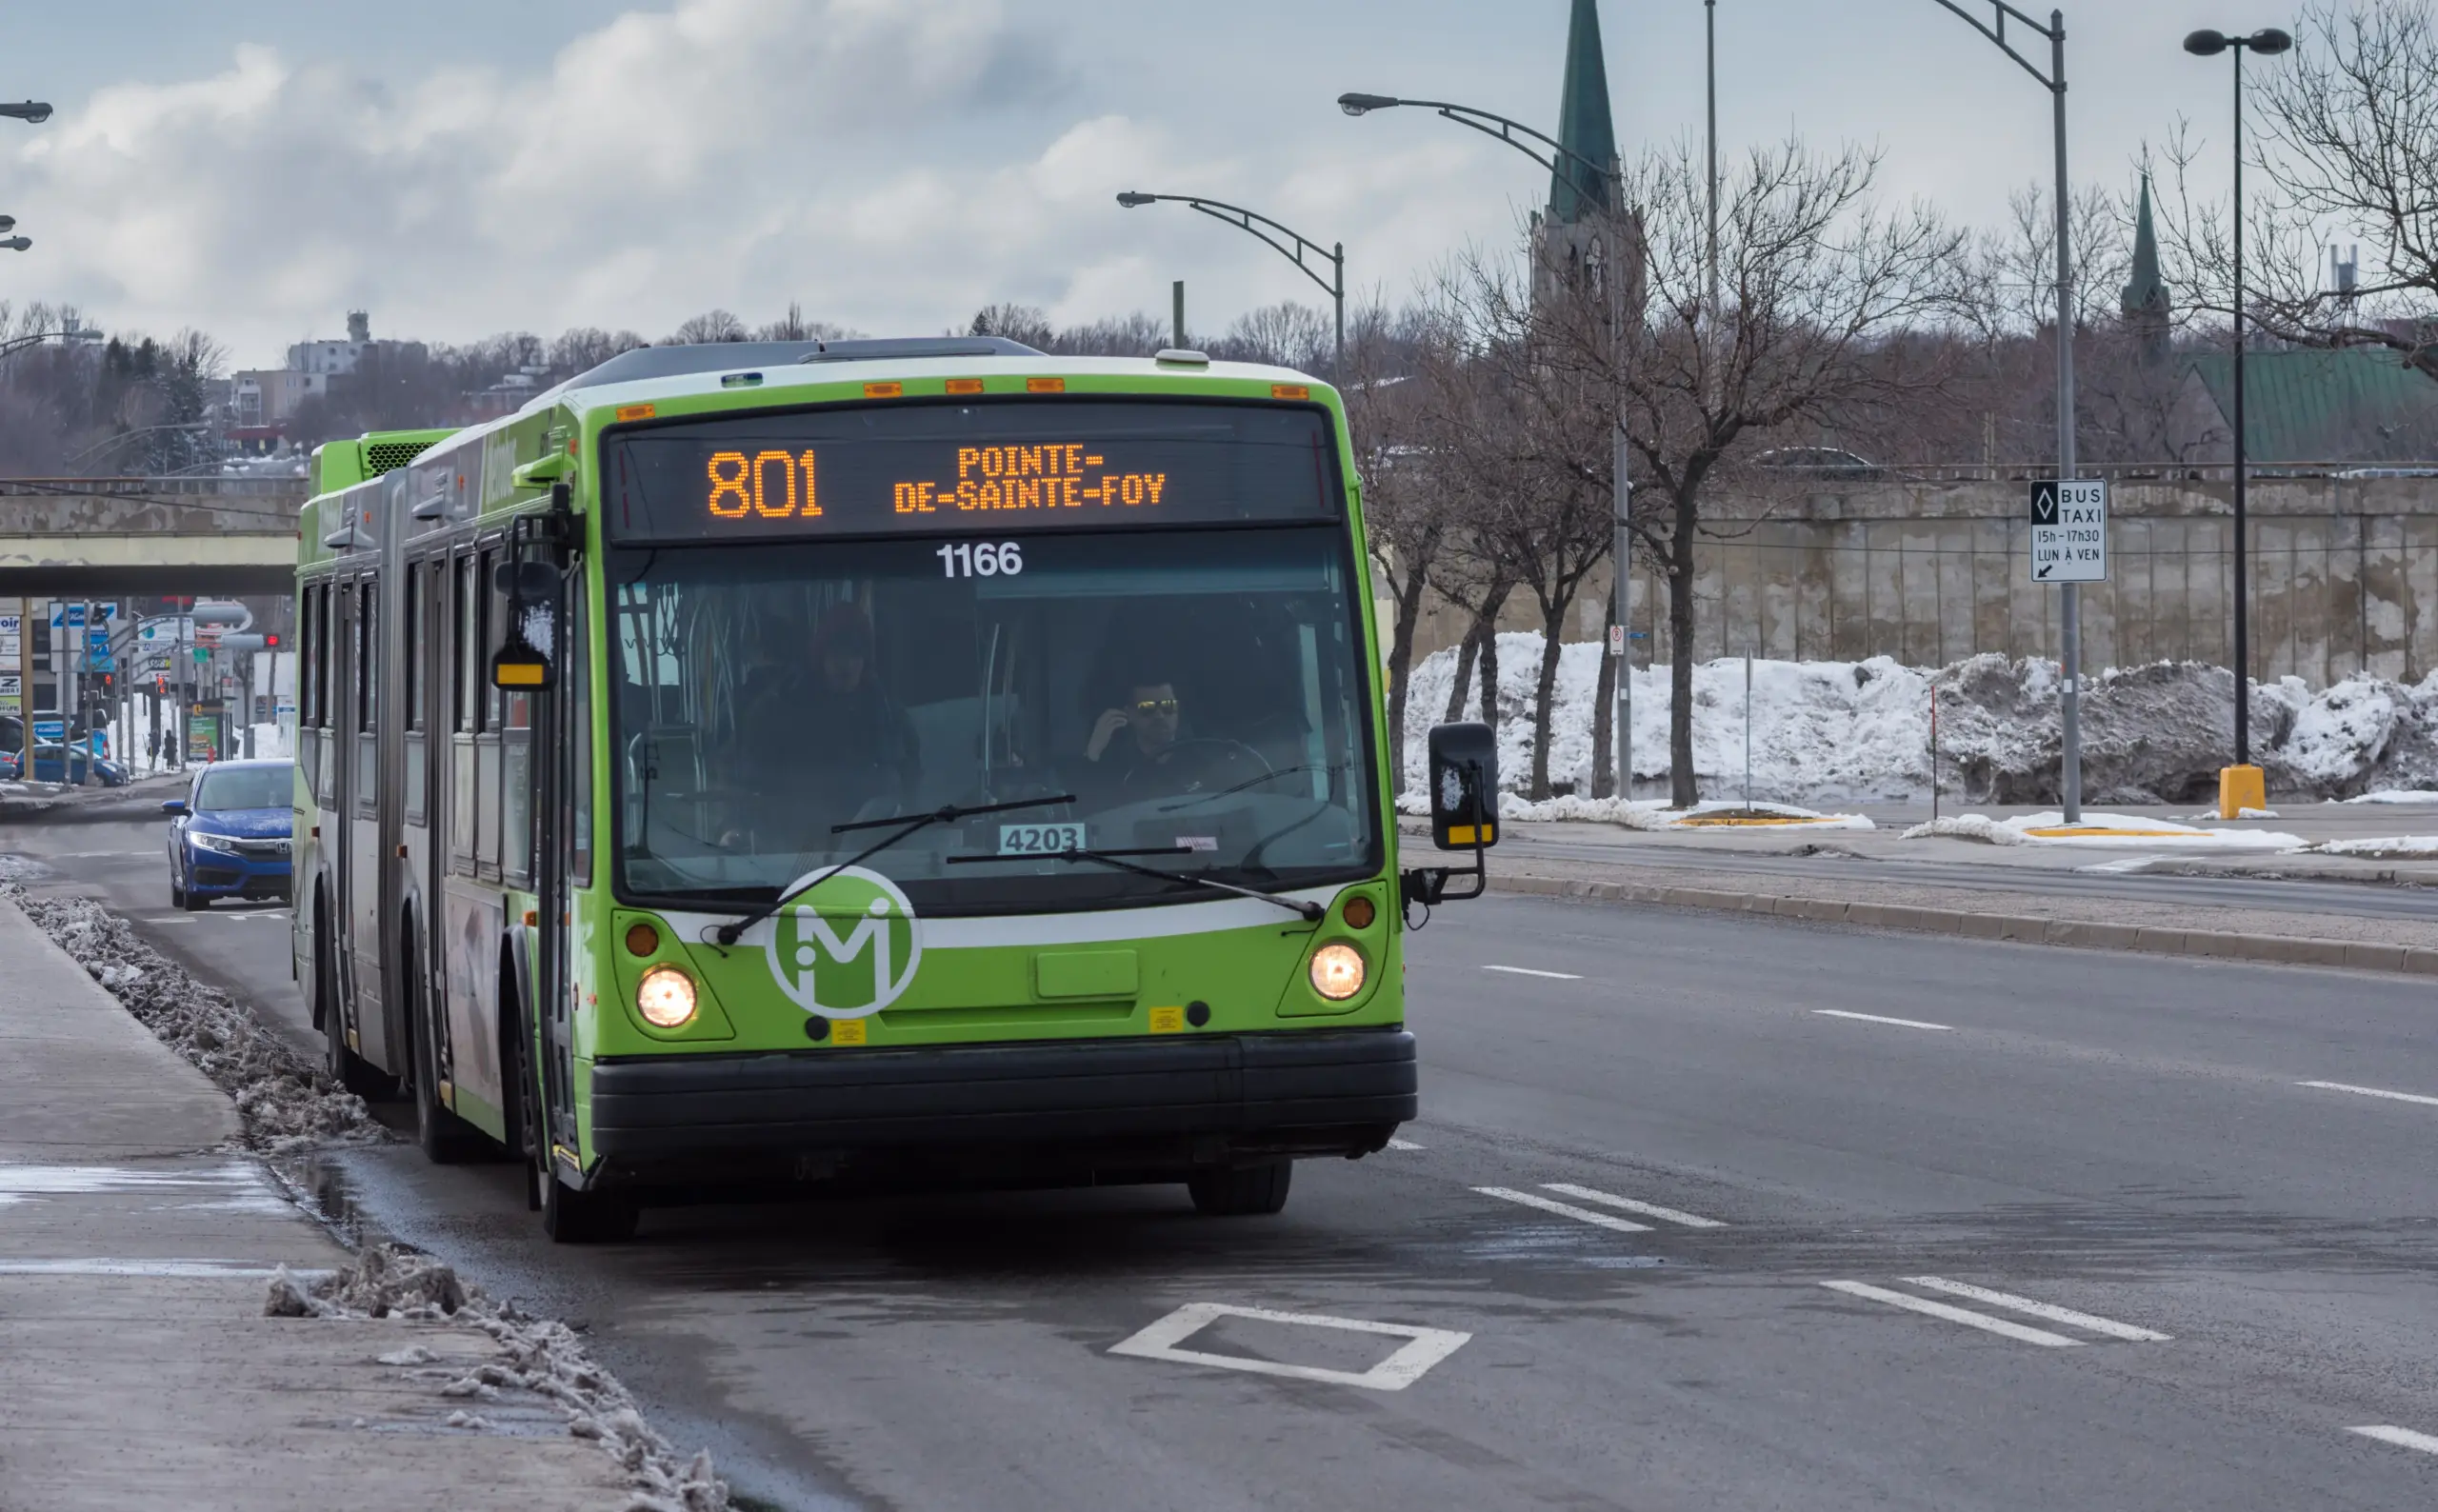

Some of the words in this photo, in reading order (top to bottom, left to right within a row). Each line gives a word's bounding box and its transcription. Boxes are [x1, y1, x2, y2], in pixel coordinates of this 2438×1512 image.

[958, 444, 1103, 478] POINTE-
[708, 448, 823, 518] 801
[894, 473, 1166, 513] DE-SAINTE-FOY
[2061, 488, 2101, 503] BUS
[2062, 508, 2101, 523] TAXI
[936, 541, 1023, 578] 1166
[2038, 549, 2059, 561] LUN
[2065, 547, 2072, 561] À
[2077, 548, 2100, 561] VEN
[1006, 827, 1079, 852] 4203
